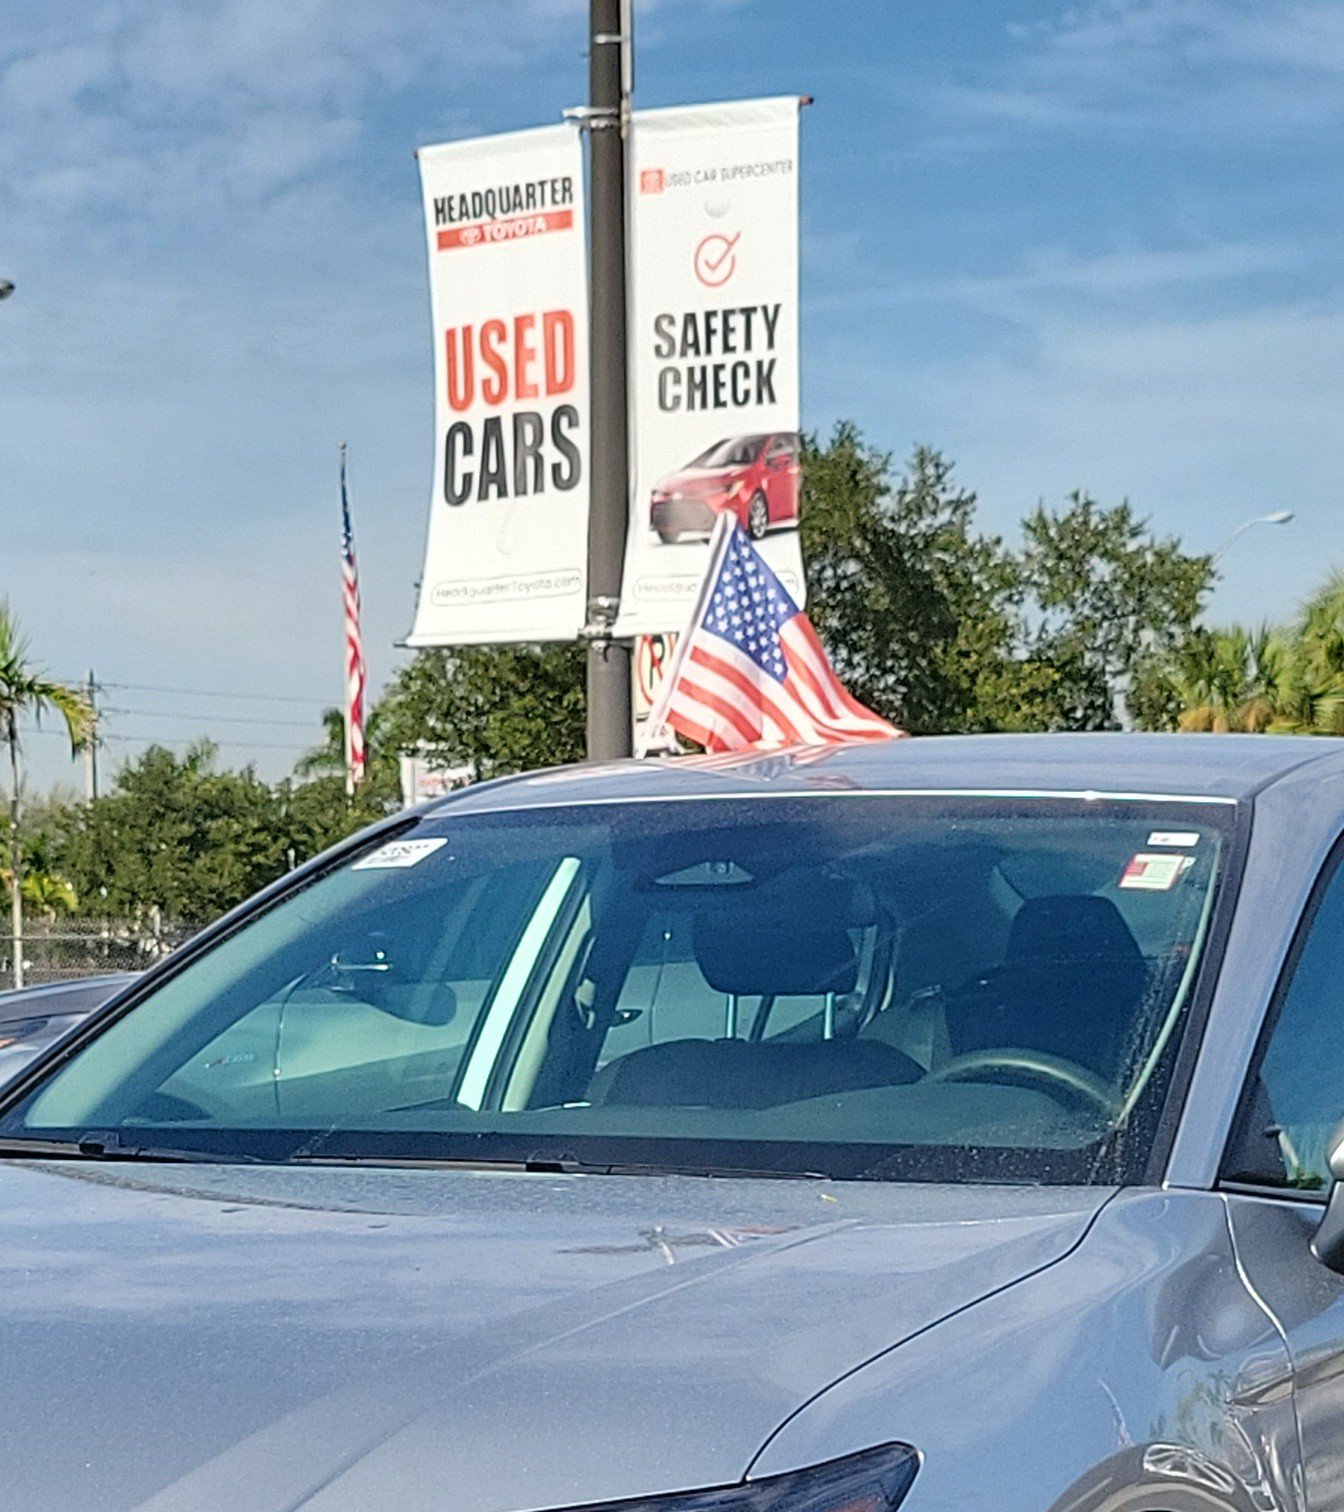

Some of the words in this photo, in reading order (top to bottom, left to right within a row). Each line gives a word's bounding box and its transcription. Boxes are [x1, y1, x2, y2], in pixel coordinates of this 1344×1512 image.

[434, 176, 573, 226] HEADQUARTER
[482, 216, 548, 243] TOYOTA
[654, 303, 782, 359] SAFETY
[445, 310, 575, 412] USED
[658, 358, 777, 412] CHECK
[444, 404, 581, 507] CARS
